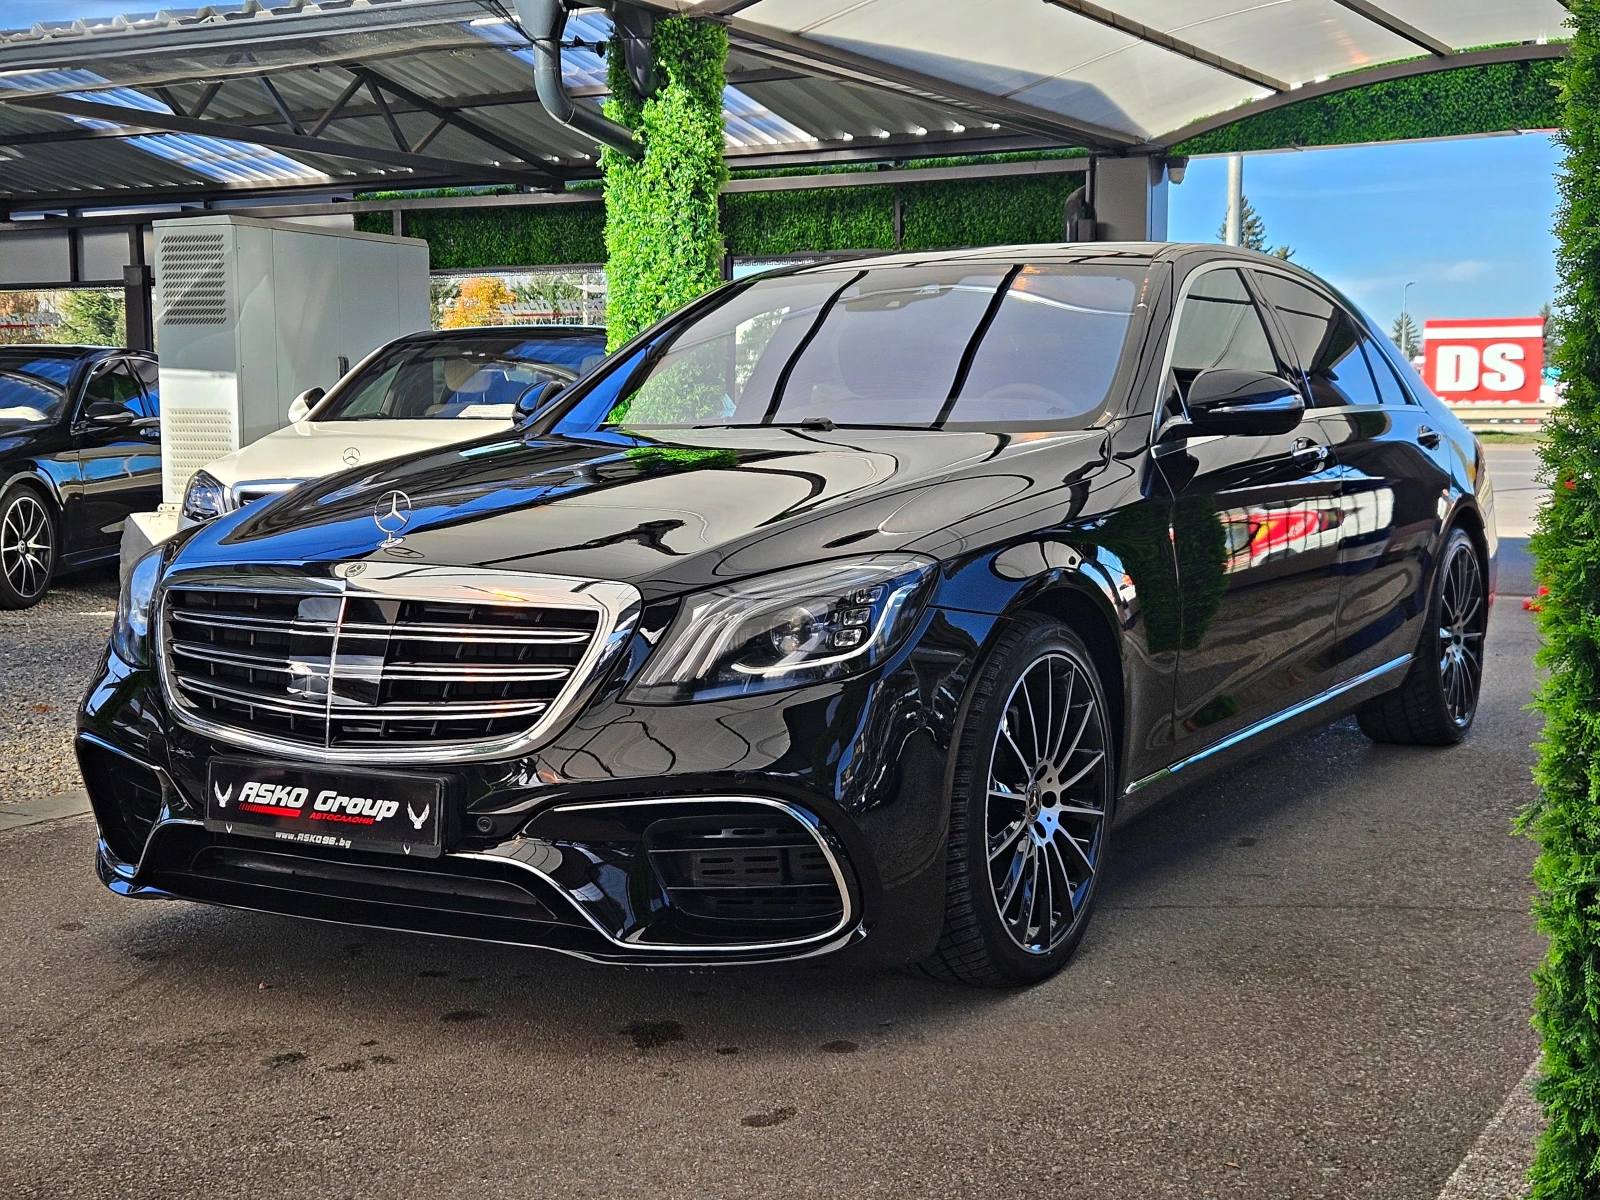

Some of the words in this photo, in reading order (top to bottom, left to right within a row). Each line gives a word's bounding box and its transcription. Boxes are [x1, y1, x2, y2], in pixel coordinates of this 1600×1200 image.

[1436, 343, 1525, 392] DS
[238, 781, 309, 808] ASKO
[313, 790, 400, 822] Group
[309, 811, 375, 825] АВТОСАЛОНИ
